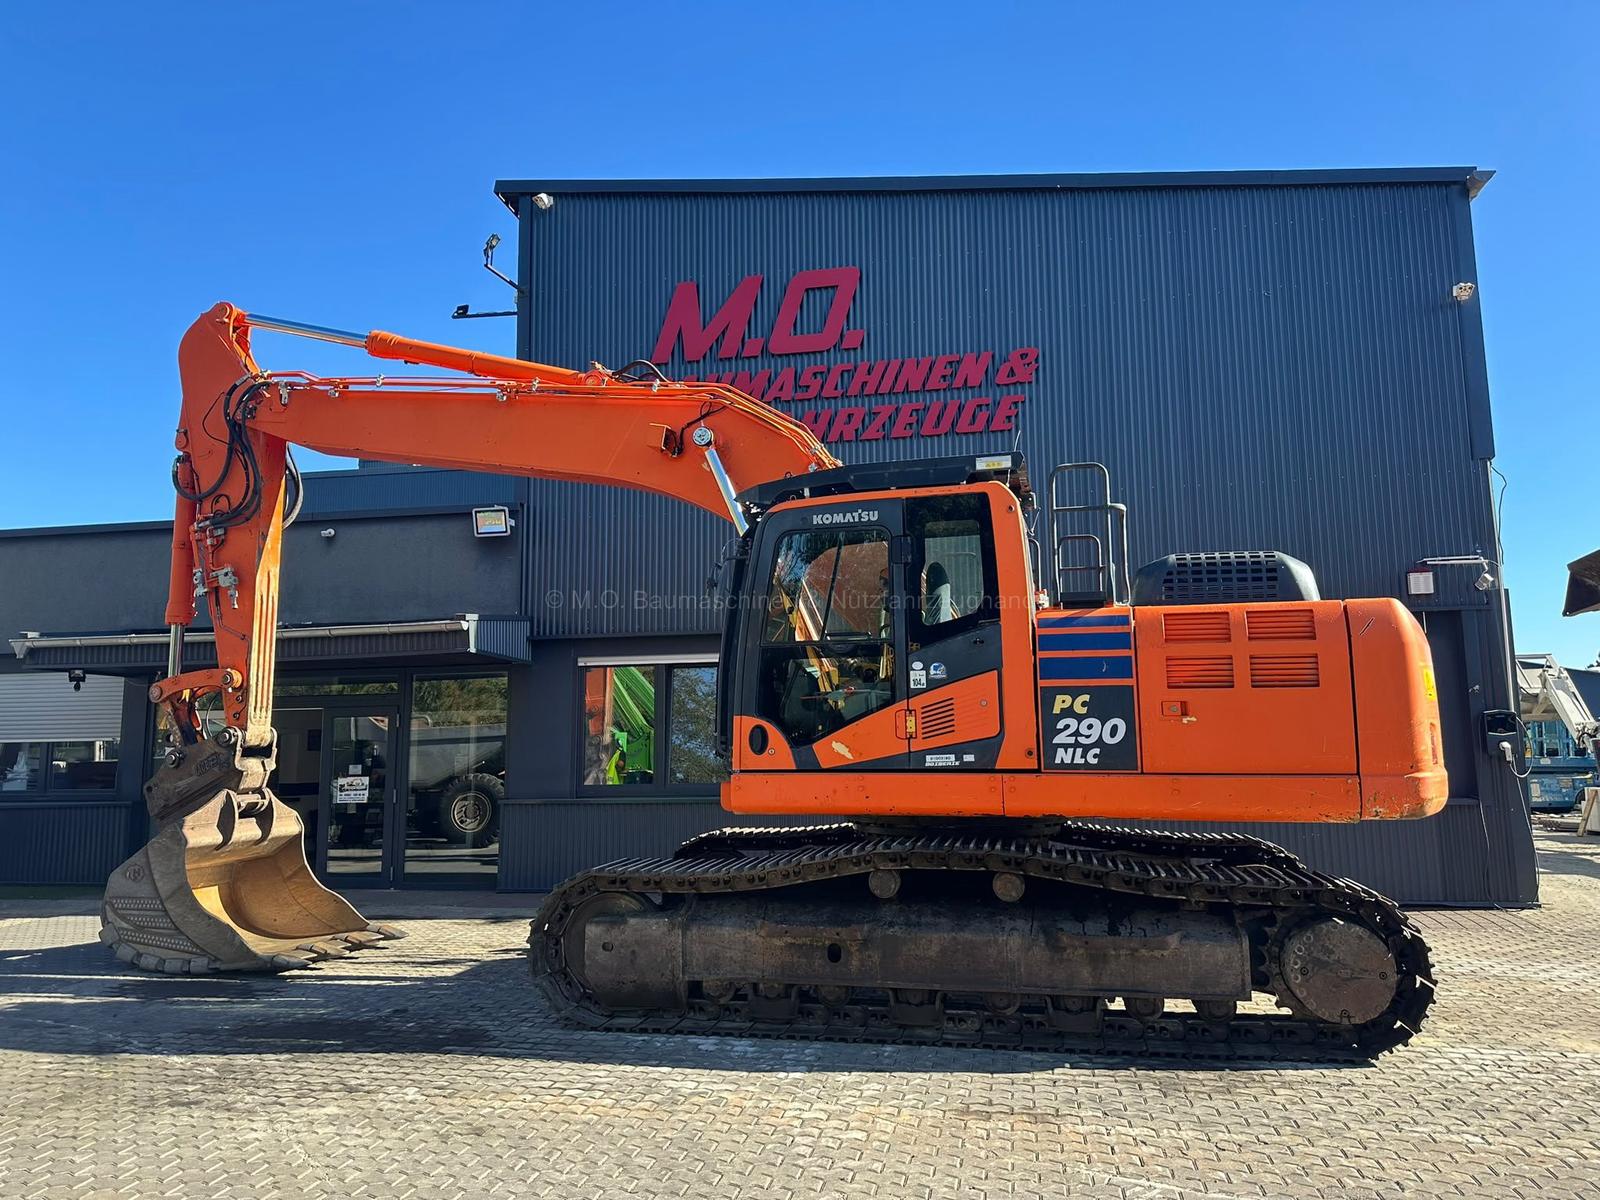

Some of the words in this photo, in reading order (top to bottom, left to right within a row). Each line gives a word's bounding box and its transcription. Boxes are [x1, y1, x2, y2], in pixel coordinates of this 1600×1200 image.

[652, 267, 865, 364] M.O.
[668, 352, 993, 402] MASCHINEN
[996, 347, 1039, 385] &
[784, 396, 1026, 443] HRZEUGE
[812, 508, 879, 525] KOMATSU
[1052, 694, 1091, 714] PC
[1052, 717, 1127, 745] 290
[1054, 747, 1101, 764] NLC
